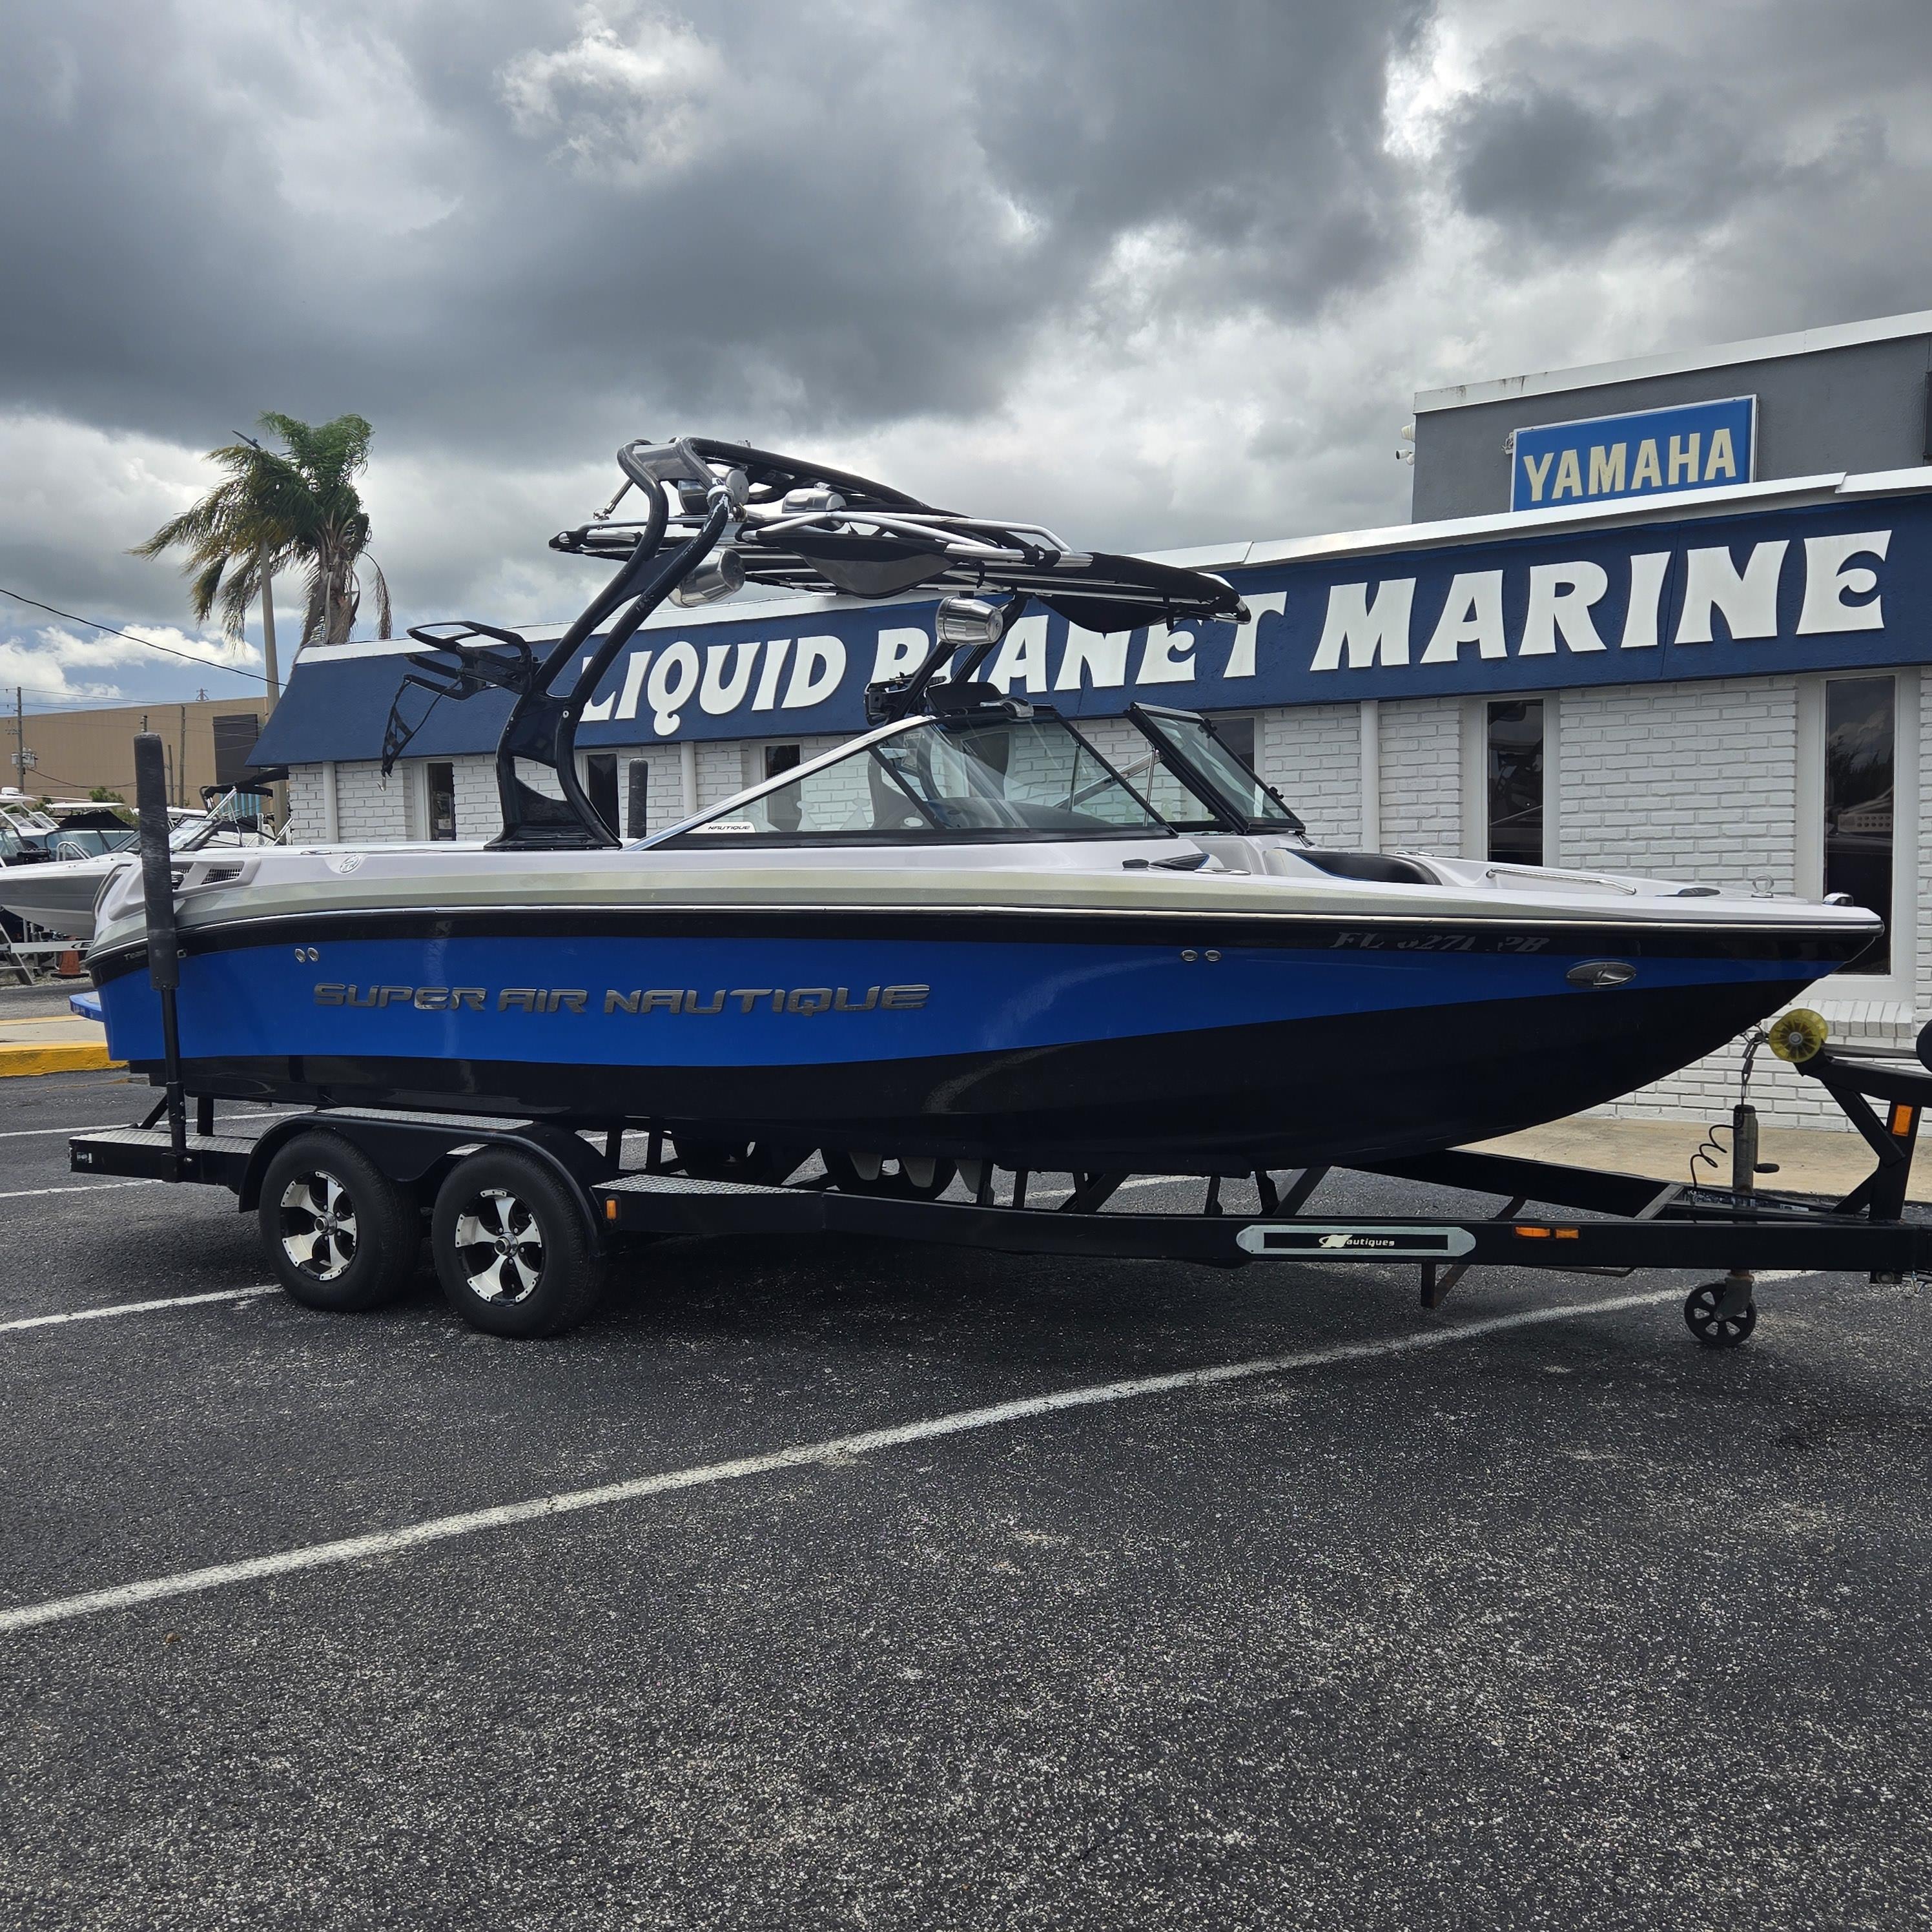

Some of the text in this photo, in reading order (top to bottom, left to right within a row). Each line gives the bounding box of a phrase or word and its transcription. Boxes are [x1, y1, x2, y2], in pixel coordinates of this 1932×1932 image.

[1523, 427, 1736, 502] YAMAHA
[869, 591, 1288, 694] PANET
[1309, 529, 1893, 672] MARINE
[1330, 932, 1385, 949] FL
[314, 983, 930, 1017] SUPER AIR NAUTIQUE
